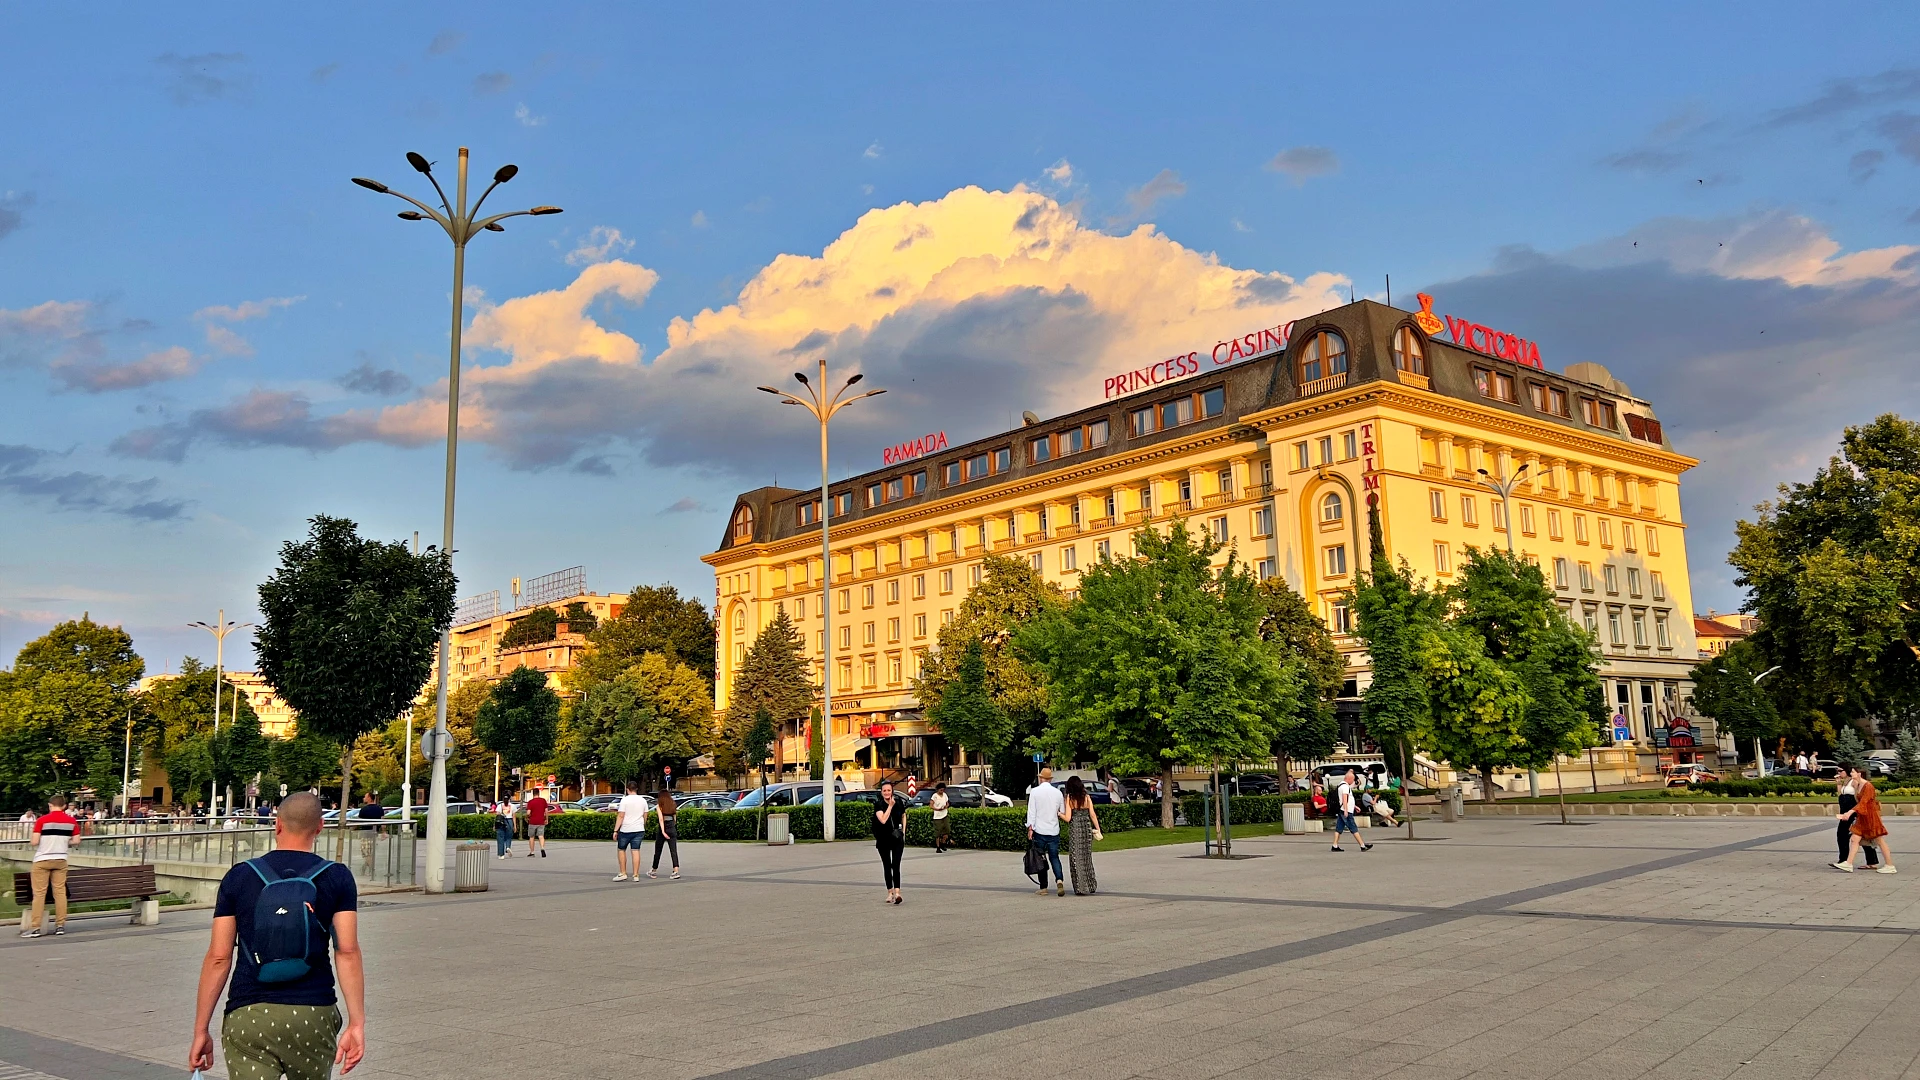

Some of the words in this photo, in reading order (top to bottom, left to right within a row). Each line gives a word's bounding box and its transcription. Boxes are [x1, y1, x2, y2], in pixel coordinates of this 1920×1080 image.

[1445, 314, 1545, 371] VICTORIA
[1104, 351, 1199, 399] PRINCESS
[883, 430, 949, 465] RAMADA
